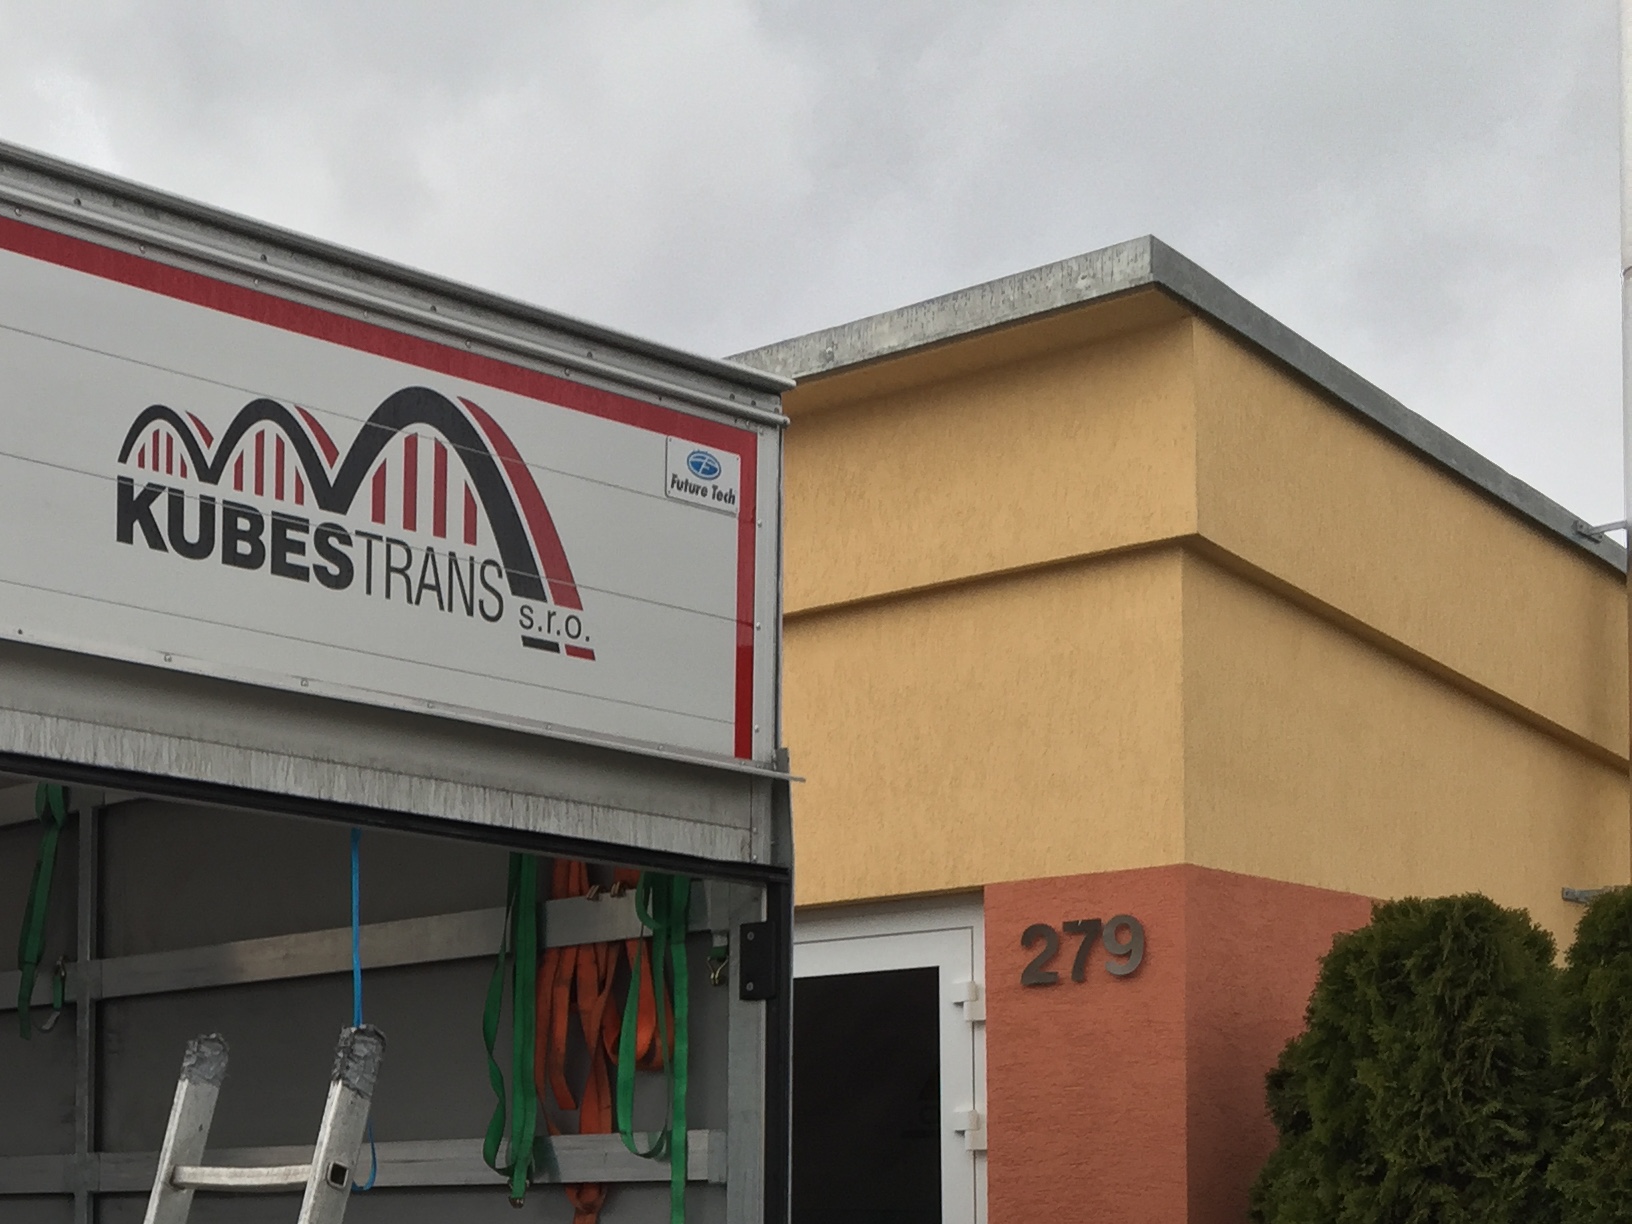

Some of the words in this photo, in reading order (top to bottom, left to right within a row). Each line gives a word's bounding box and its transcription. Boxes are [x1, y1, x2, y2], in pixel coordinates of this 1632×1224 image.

[670, 473, 708, 498] Future
[711, 484, 736, 506] Tech
[518, 604, 591, 643] s.r.o.
[1021, 913, 1145, 986] 279
